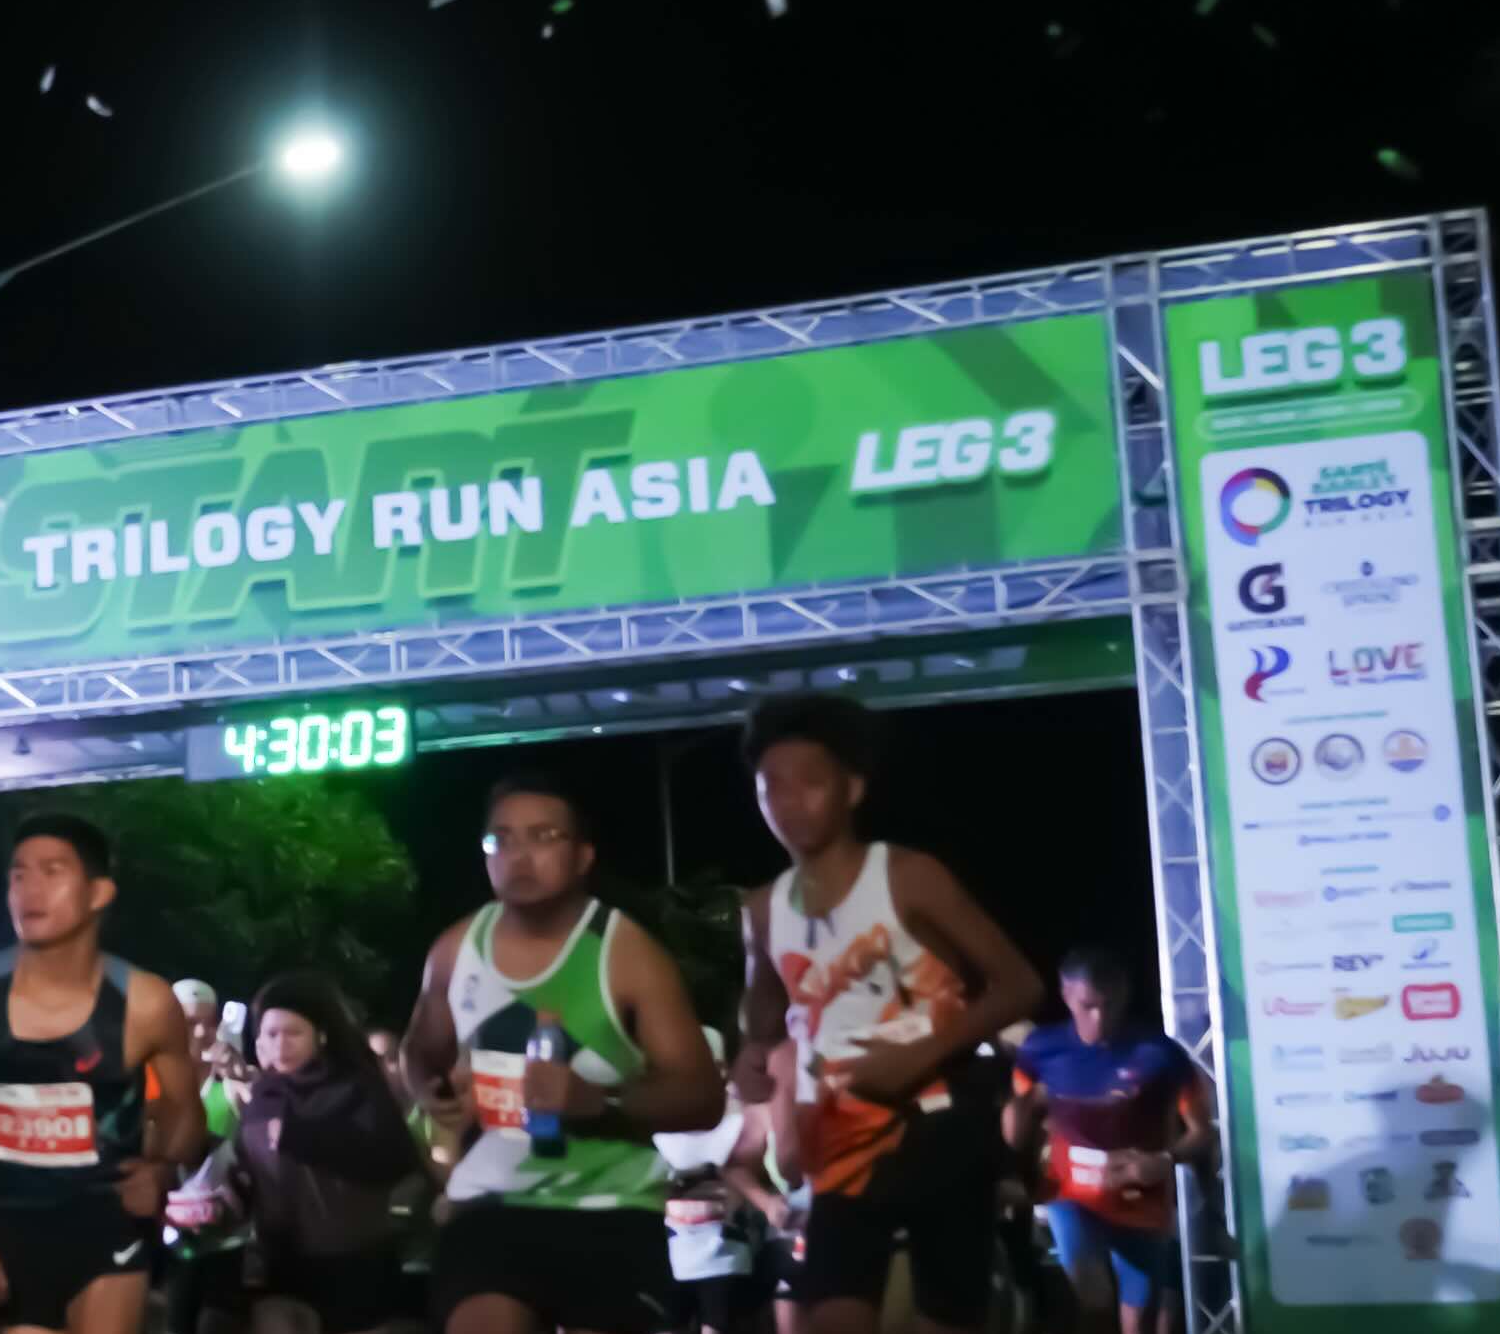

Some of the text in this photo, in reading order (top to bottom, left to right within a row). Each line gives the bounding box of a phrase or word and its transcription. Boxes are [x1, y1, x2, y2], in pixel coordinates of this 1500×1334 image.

[1198, 317, 1407, 396] LEG 3
[849, 409, 1056, 495] LEG 3
[23, 450, 777, 589] TRILOGY RUN ASIA
[1327, 642, 1424, 677] LOVE
[224, 707, 408, 774] 4:30:03
